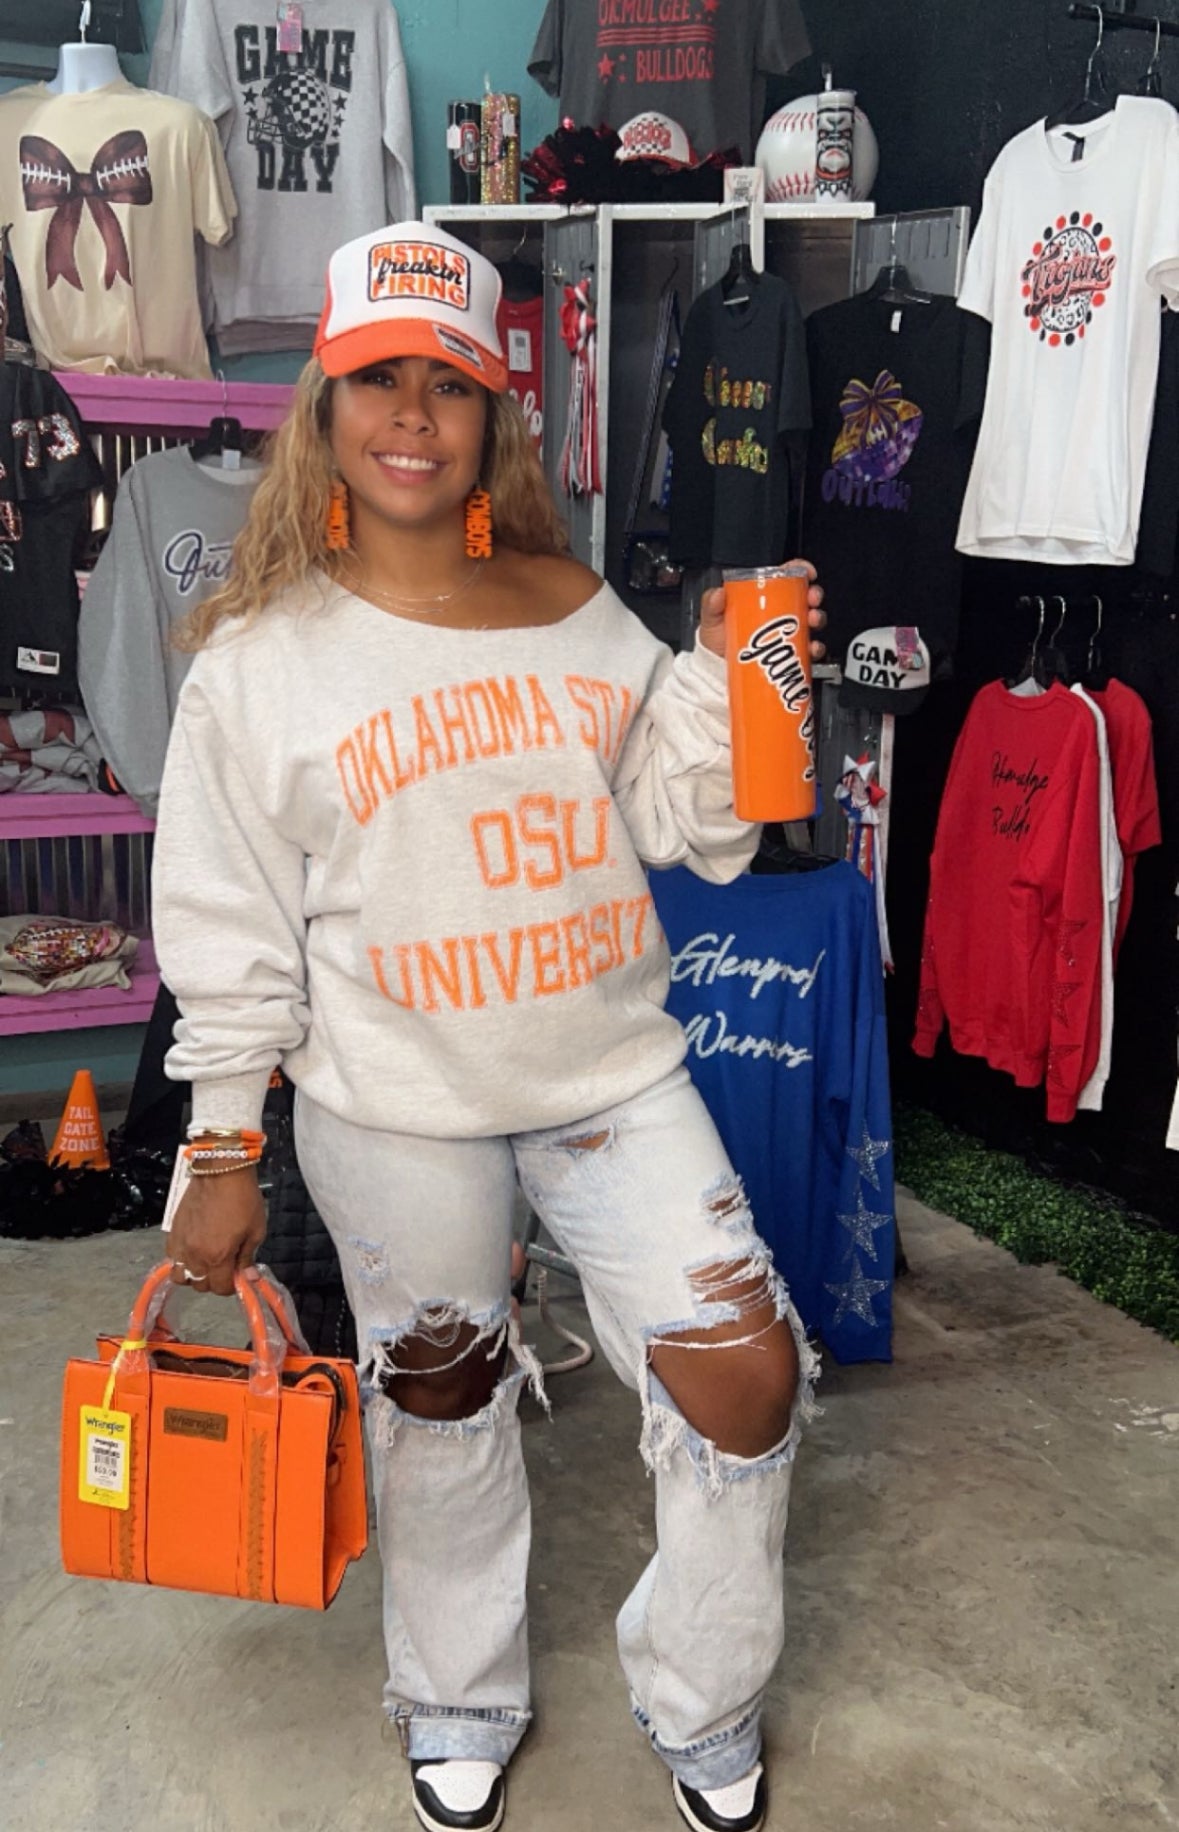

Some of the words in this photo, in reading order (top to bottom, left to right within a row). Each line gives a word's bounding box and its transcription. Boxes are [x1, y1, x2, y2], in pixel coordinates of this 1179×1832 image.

[256, 141, 340, 193] DAY
[372, 274, 465, 306] FIRING
[739, 616, 812, 712] Game
[859, 664, 907, 689] DAY
[335, 673, 566, 828] OKLAHOMA
[469, 791, 613, 891] OSU
[367, 894, 654, 1013] UNIVERSIT
[64, 1121, 97, 1135] GATE
[69, 1105, 94, 1121] TAIL
[59, 1136, 100, 1152] ZONE
